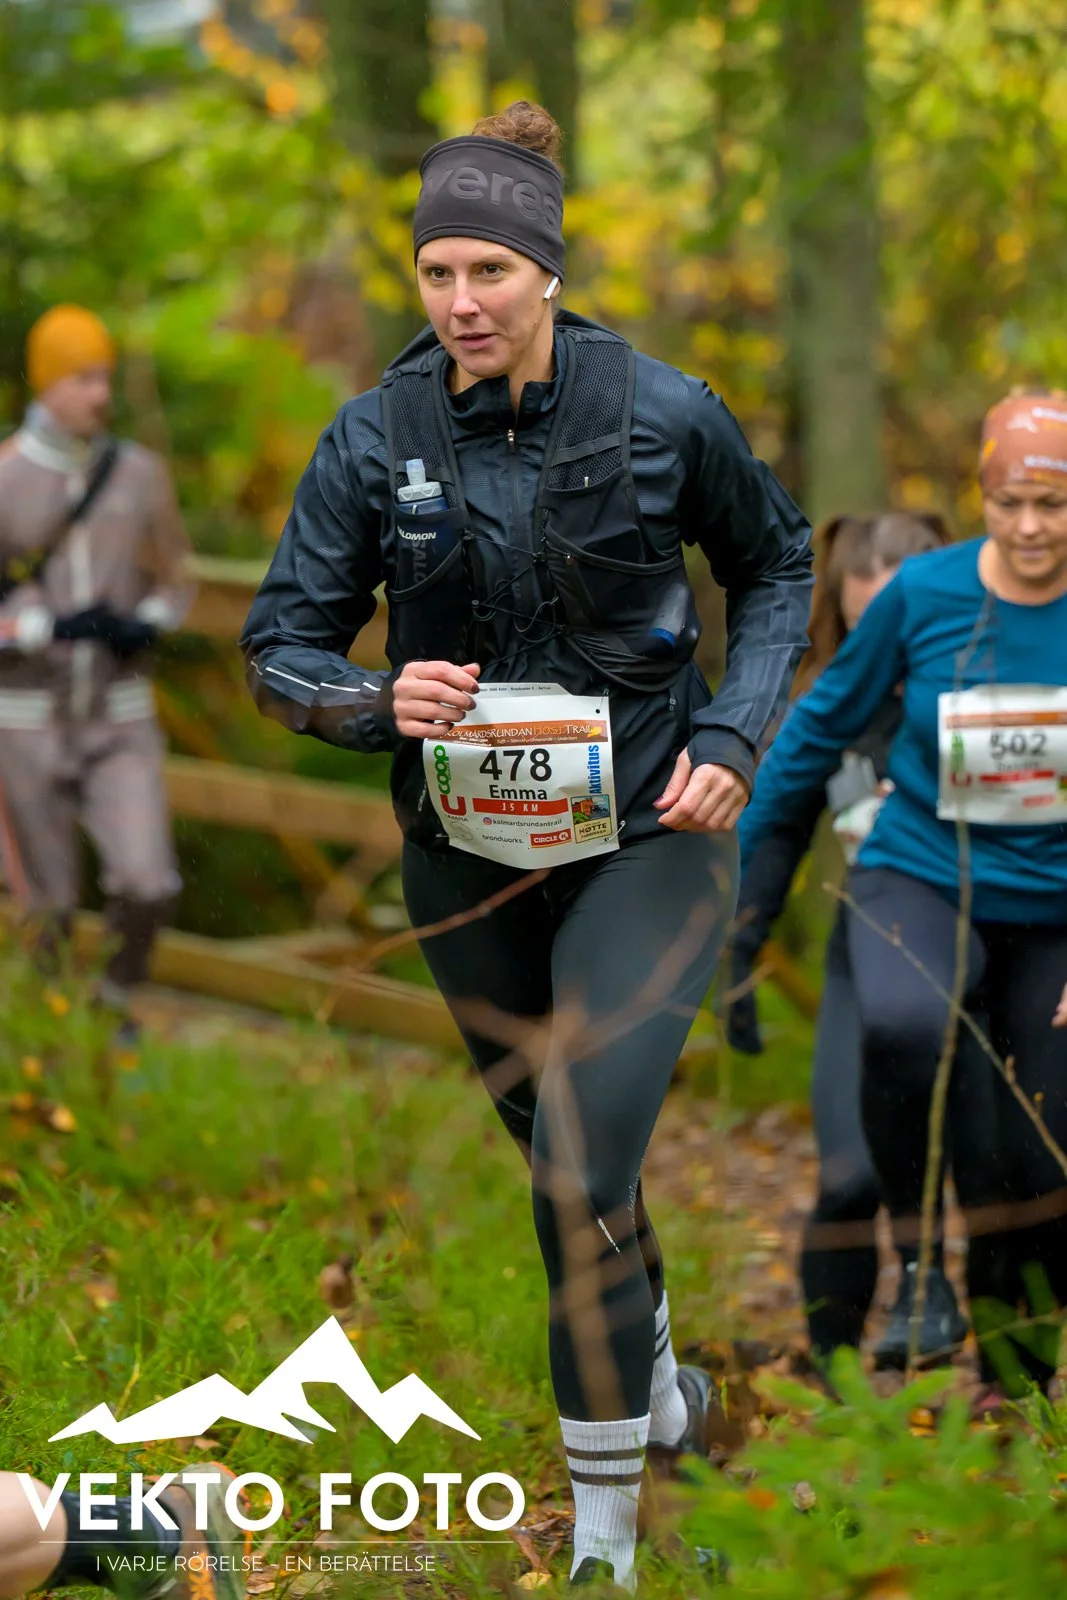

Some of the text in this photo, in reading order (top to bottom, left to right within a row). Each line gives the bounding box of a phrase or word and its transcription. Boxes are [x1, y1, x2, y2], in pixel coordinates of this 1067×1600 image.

[988, 732, 1047, 759] 502
[433, 745, 451, 795] coop
[479, 748, 552, 782] 478
[587, 745, 602, 794] Aktivitus
[489, 785, 548, 800] Emma
[502, 802, 539, 812] 15 KM
[492, 818, 562, 828] kolmardsrundantrail
